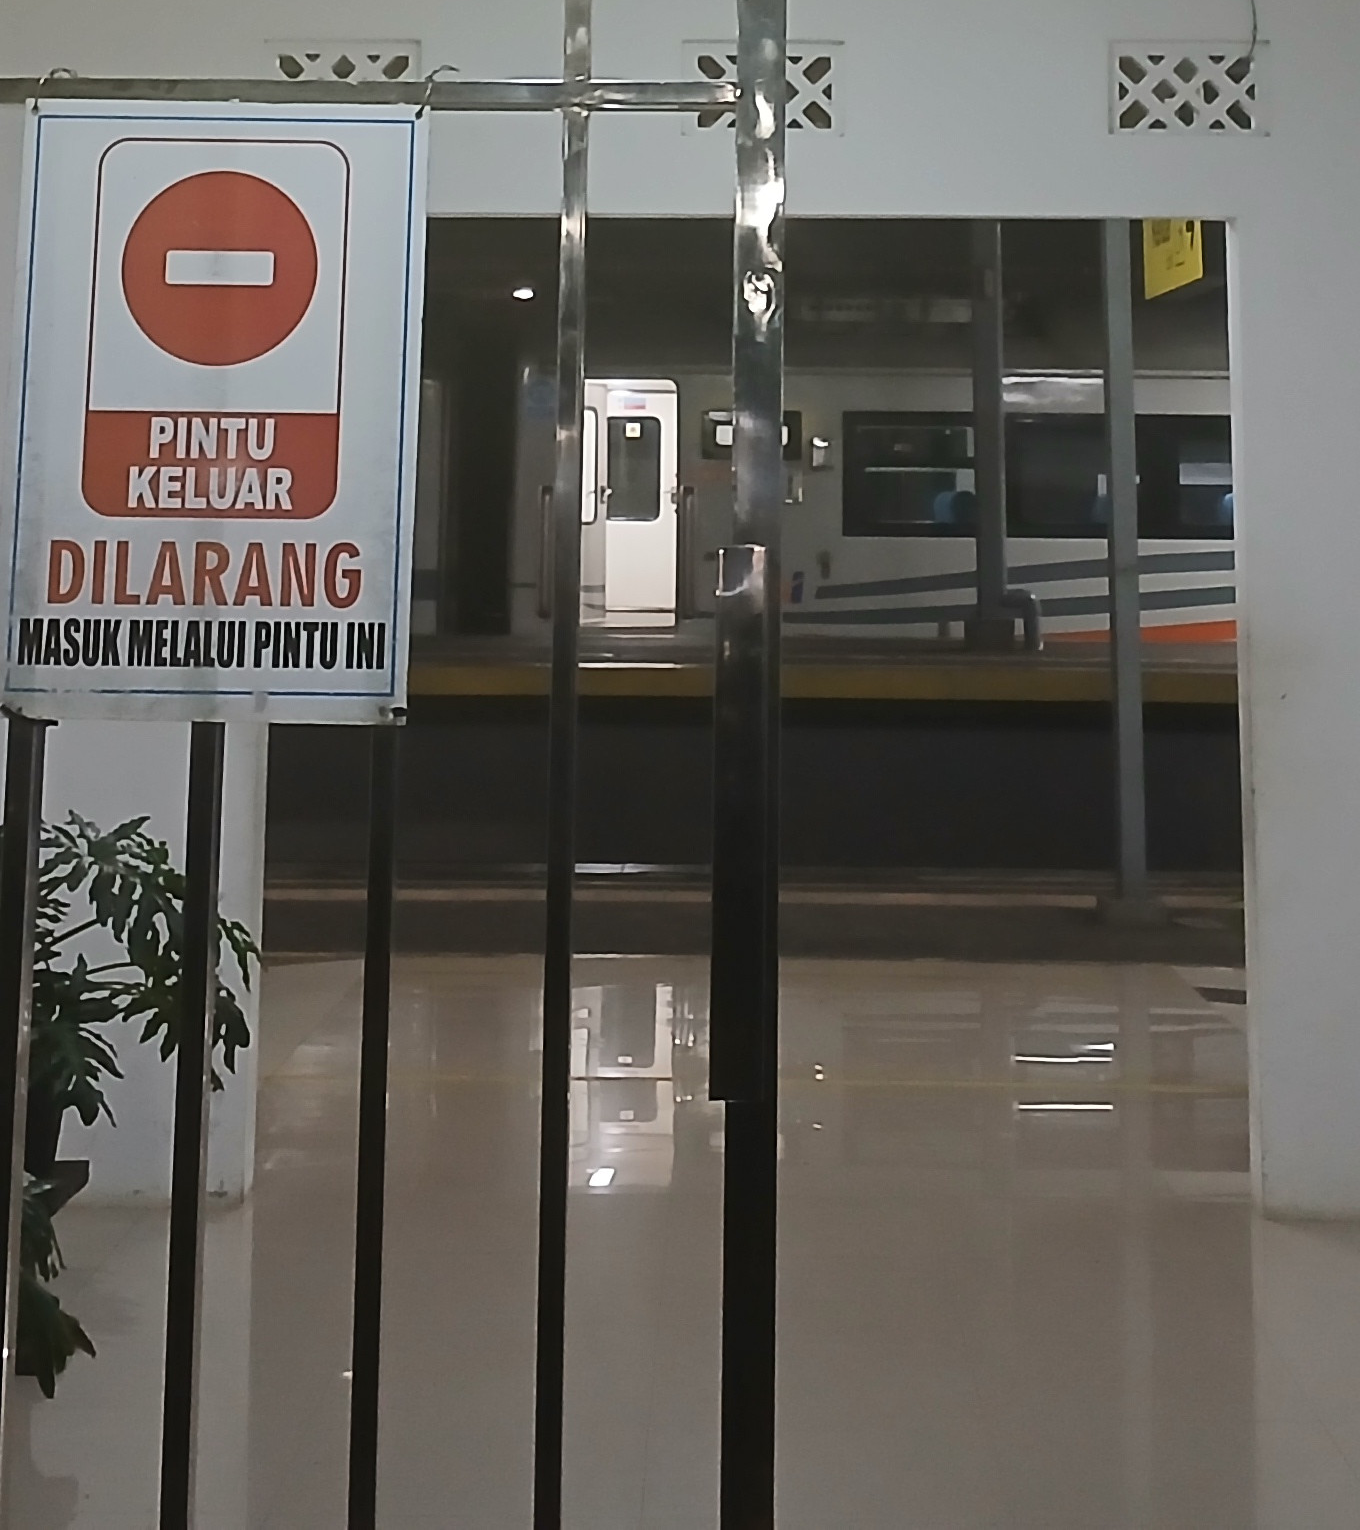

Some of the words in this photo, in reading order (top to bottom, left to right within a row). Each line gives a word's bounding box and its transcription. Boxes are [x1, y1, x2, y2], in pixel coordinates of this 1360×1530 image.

[149, 416, 277, 461] PINTU
[126, 465, 294, 511] KELUAR
[45, 538, 363, 609] DILARANG
[17, 616, 122, 669] MASUK
[126, 617, 247, 670] MELALUI
[252, 620, 340, 670] PINTU
[345, 621, 387, 671] INI
